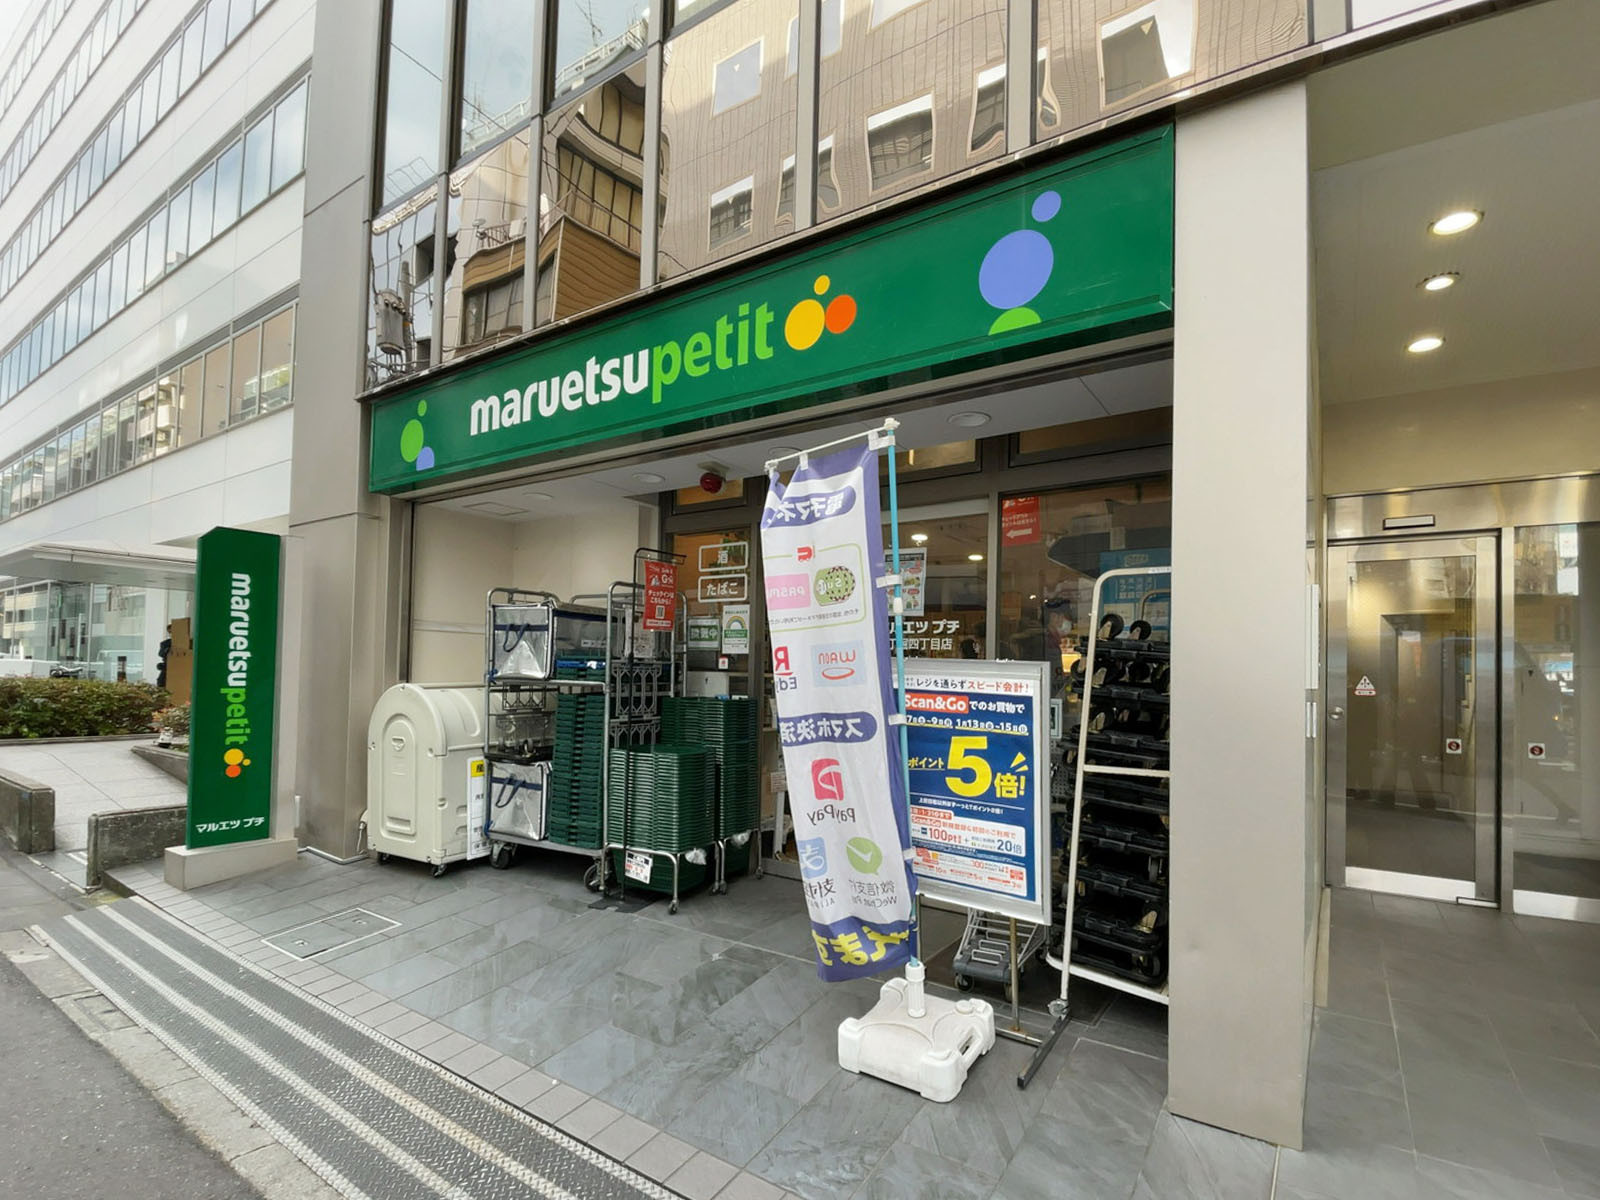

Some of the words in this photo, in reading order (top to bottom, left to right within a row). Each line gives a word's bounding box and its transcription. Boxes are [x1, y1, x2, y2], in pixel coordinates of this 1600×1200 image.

[718, 550, 729, 563] 酒
[706, 581, 739, 596] たばこ
[932, 619, 960, 634] プチ
[905, 695, 967, 712] Scan&Go
[969, 700, 1025, 714] でのお買物で
[195, 818, 241, 833] マルエツ
[243, 816, 265, 828] プチ
